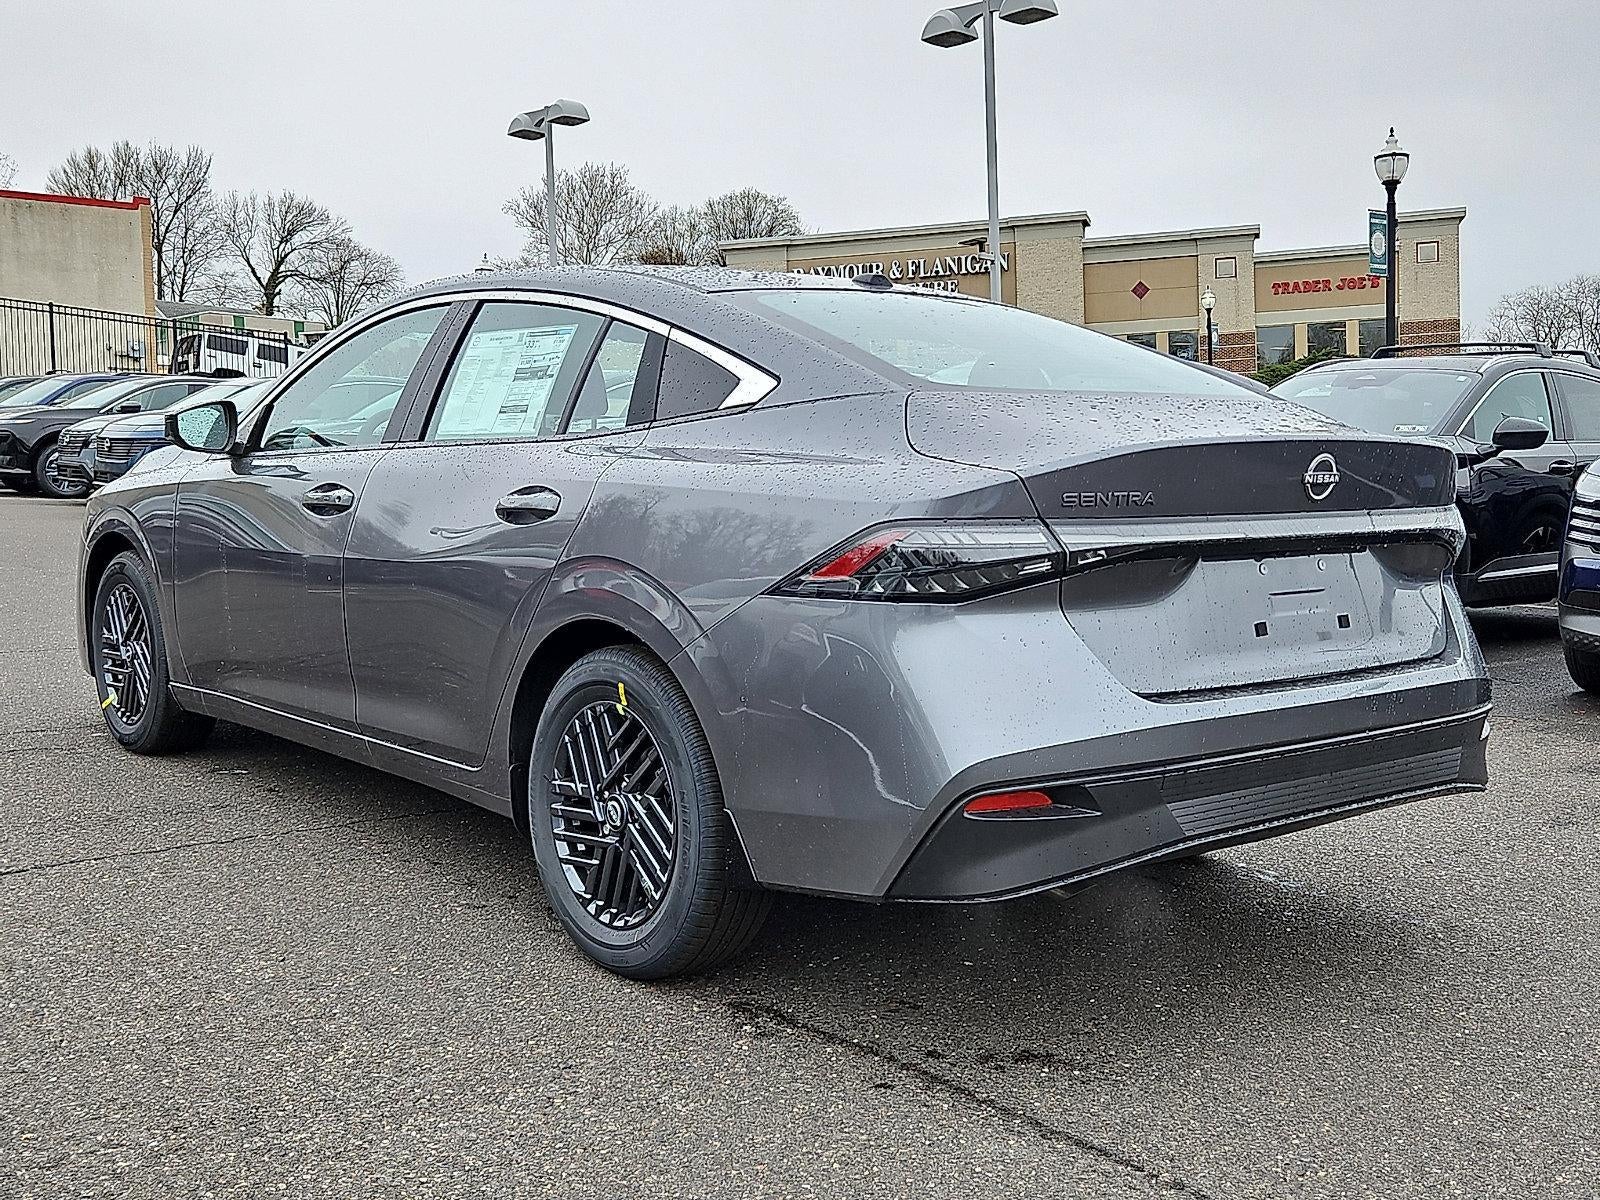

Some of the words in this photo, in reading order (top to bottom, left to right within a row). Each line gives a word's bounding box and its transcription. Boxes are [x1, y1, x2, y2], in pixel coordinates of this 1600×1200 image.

[888, 260, 904, 279] &
[1271, 279, 1332, 295] TRADER
[1335, 276, 1380, 290] JOE'S
[1304, 474, 1340, 484] NISSAN
[1062, 491, 1155, 507] SENTRA
